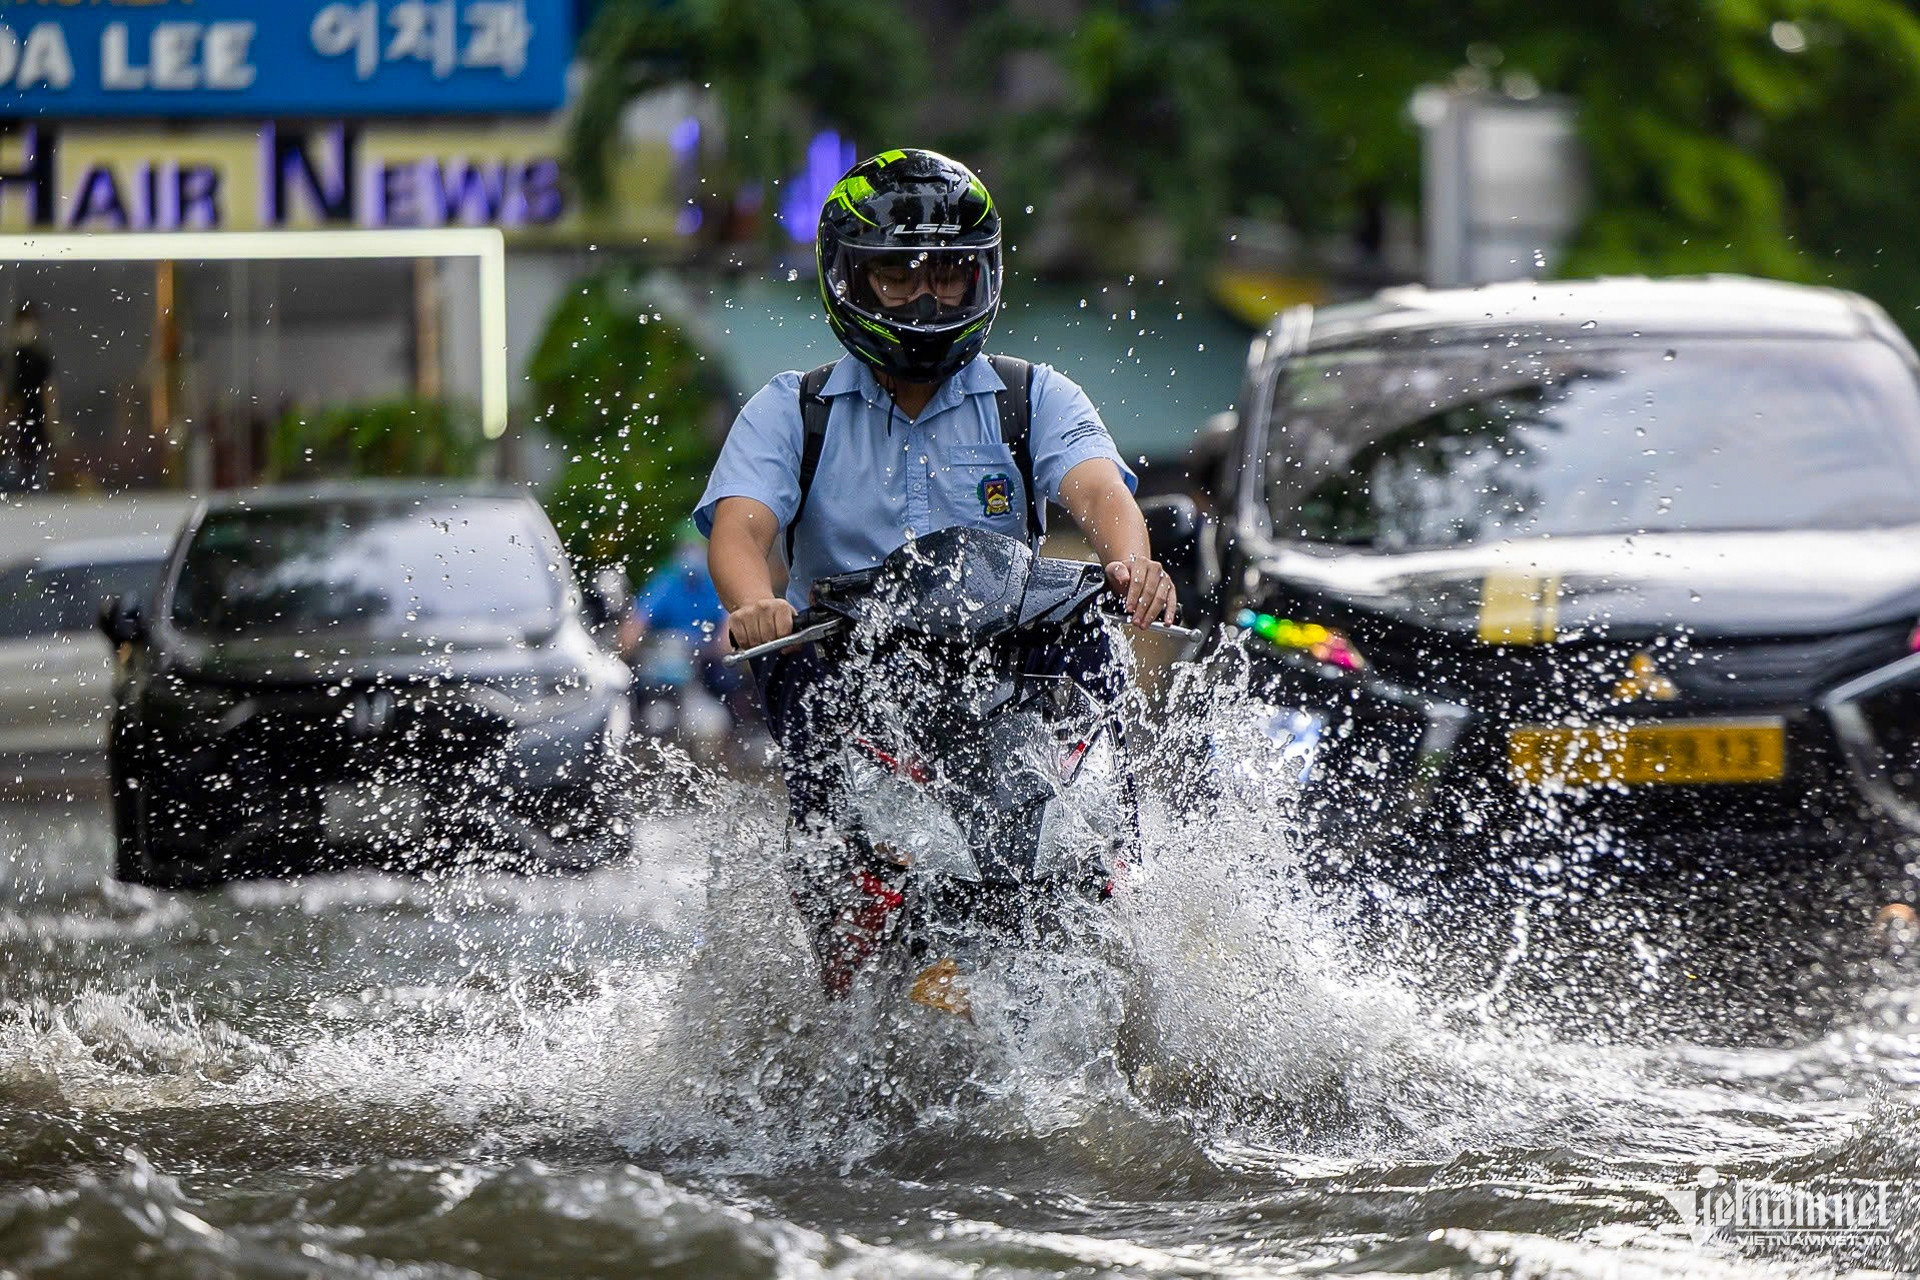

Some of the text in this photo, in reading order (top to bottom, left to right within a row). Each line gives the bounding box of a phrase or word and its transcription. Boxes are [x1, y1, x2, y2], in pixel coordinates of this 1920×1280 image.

[101, 21, 256, 90] LEE
[257, 120, 562, 229] NEWS
[893, 223, 962, 234] LS2
